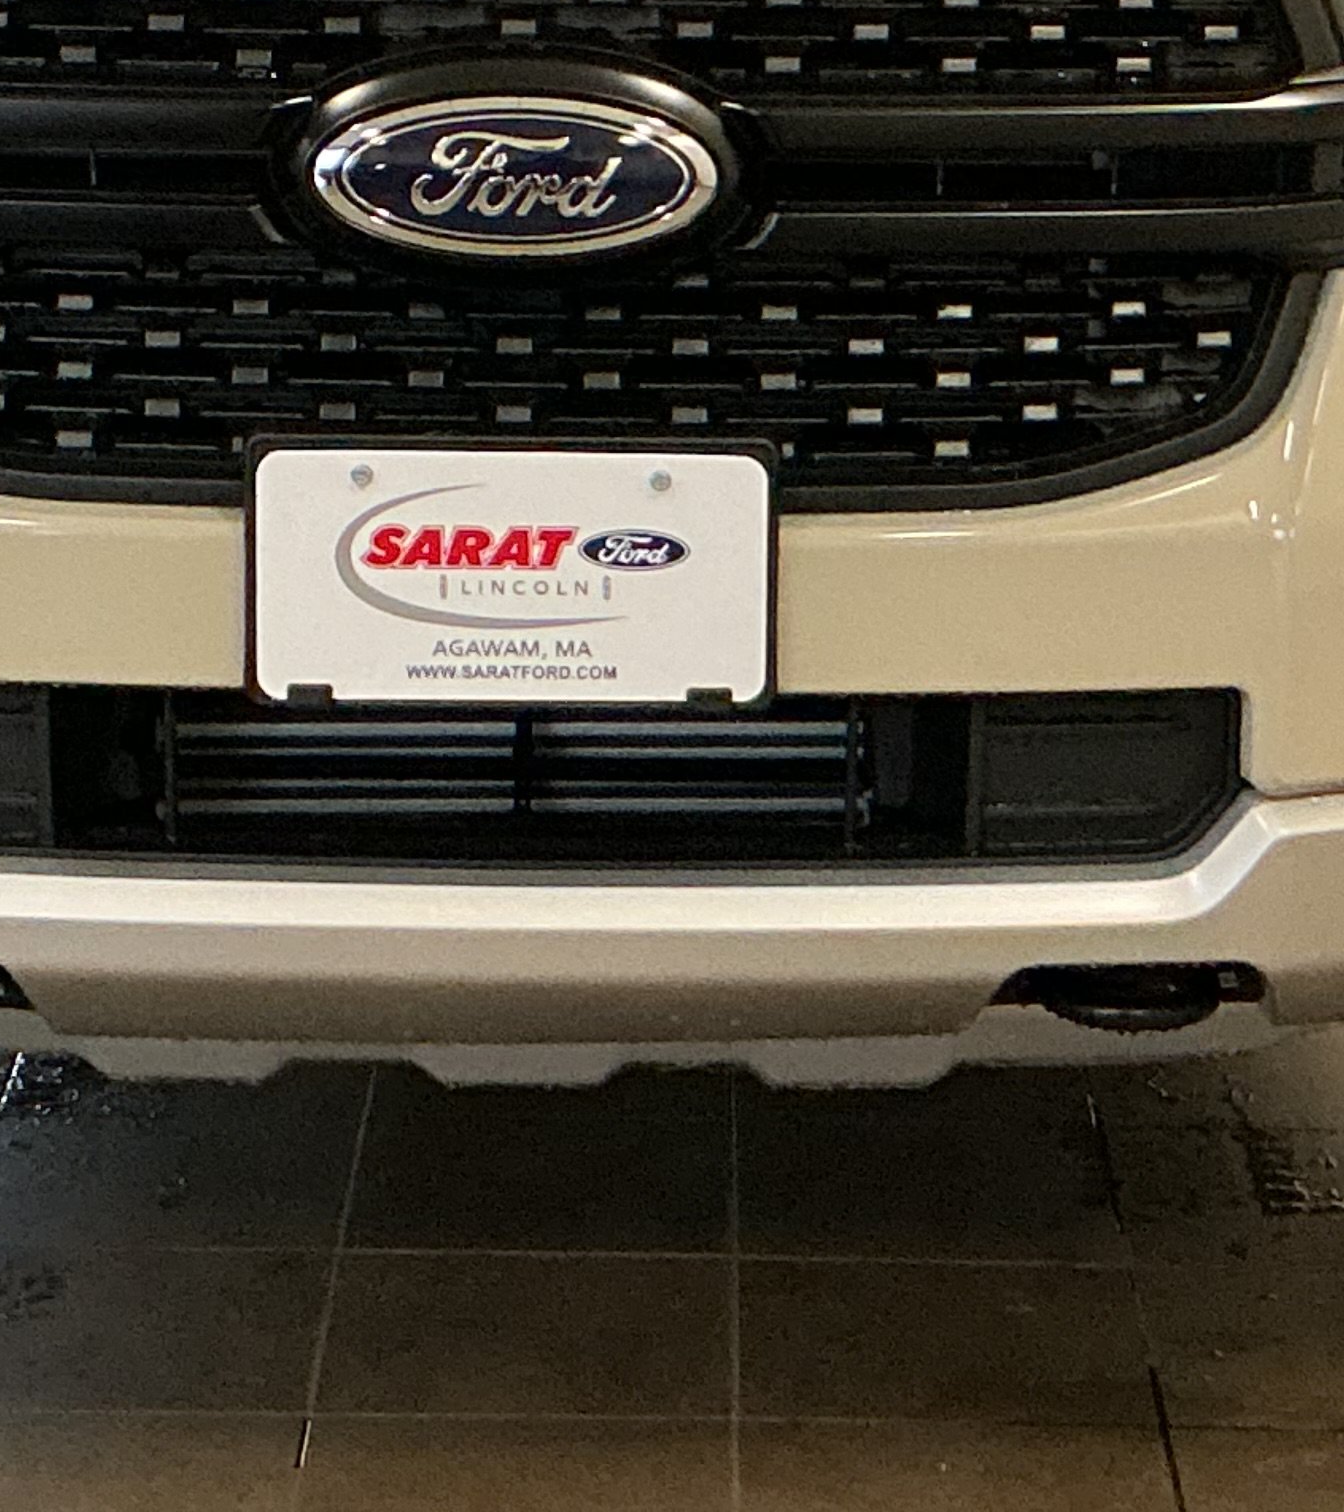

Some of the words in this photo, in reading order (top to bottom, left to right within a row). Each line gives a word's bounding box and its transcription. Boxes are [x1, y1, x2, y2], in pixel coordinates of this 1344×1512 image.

[409, 130, 624, 218] Ford
[360, 524, 579, 570] SARAT
[596, 534, 670, 566] Ford
[460, 579, 590, 597] LINCOLN
[431, 639, 549, 661] AGAWAM,
[555, 639, 593, 658] MA
[405, 664, 618, 682] WWW.SARATFORD.COM
